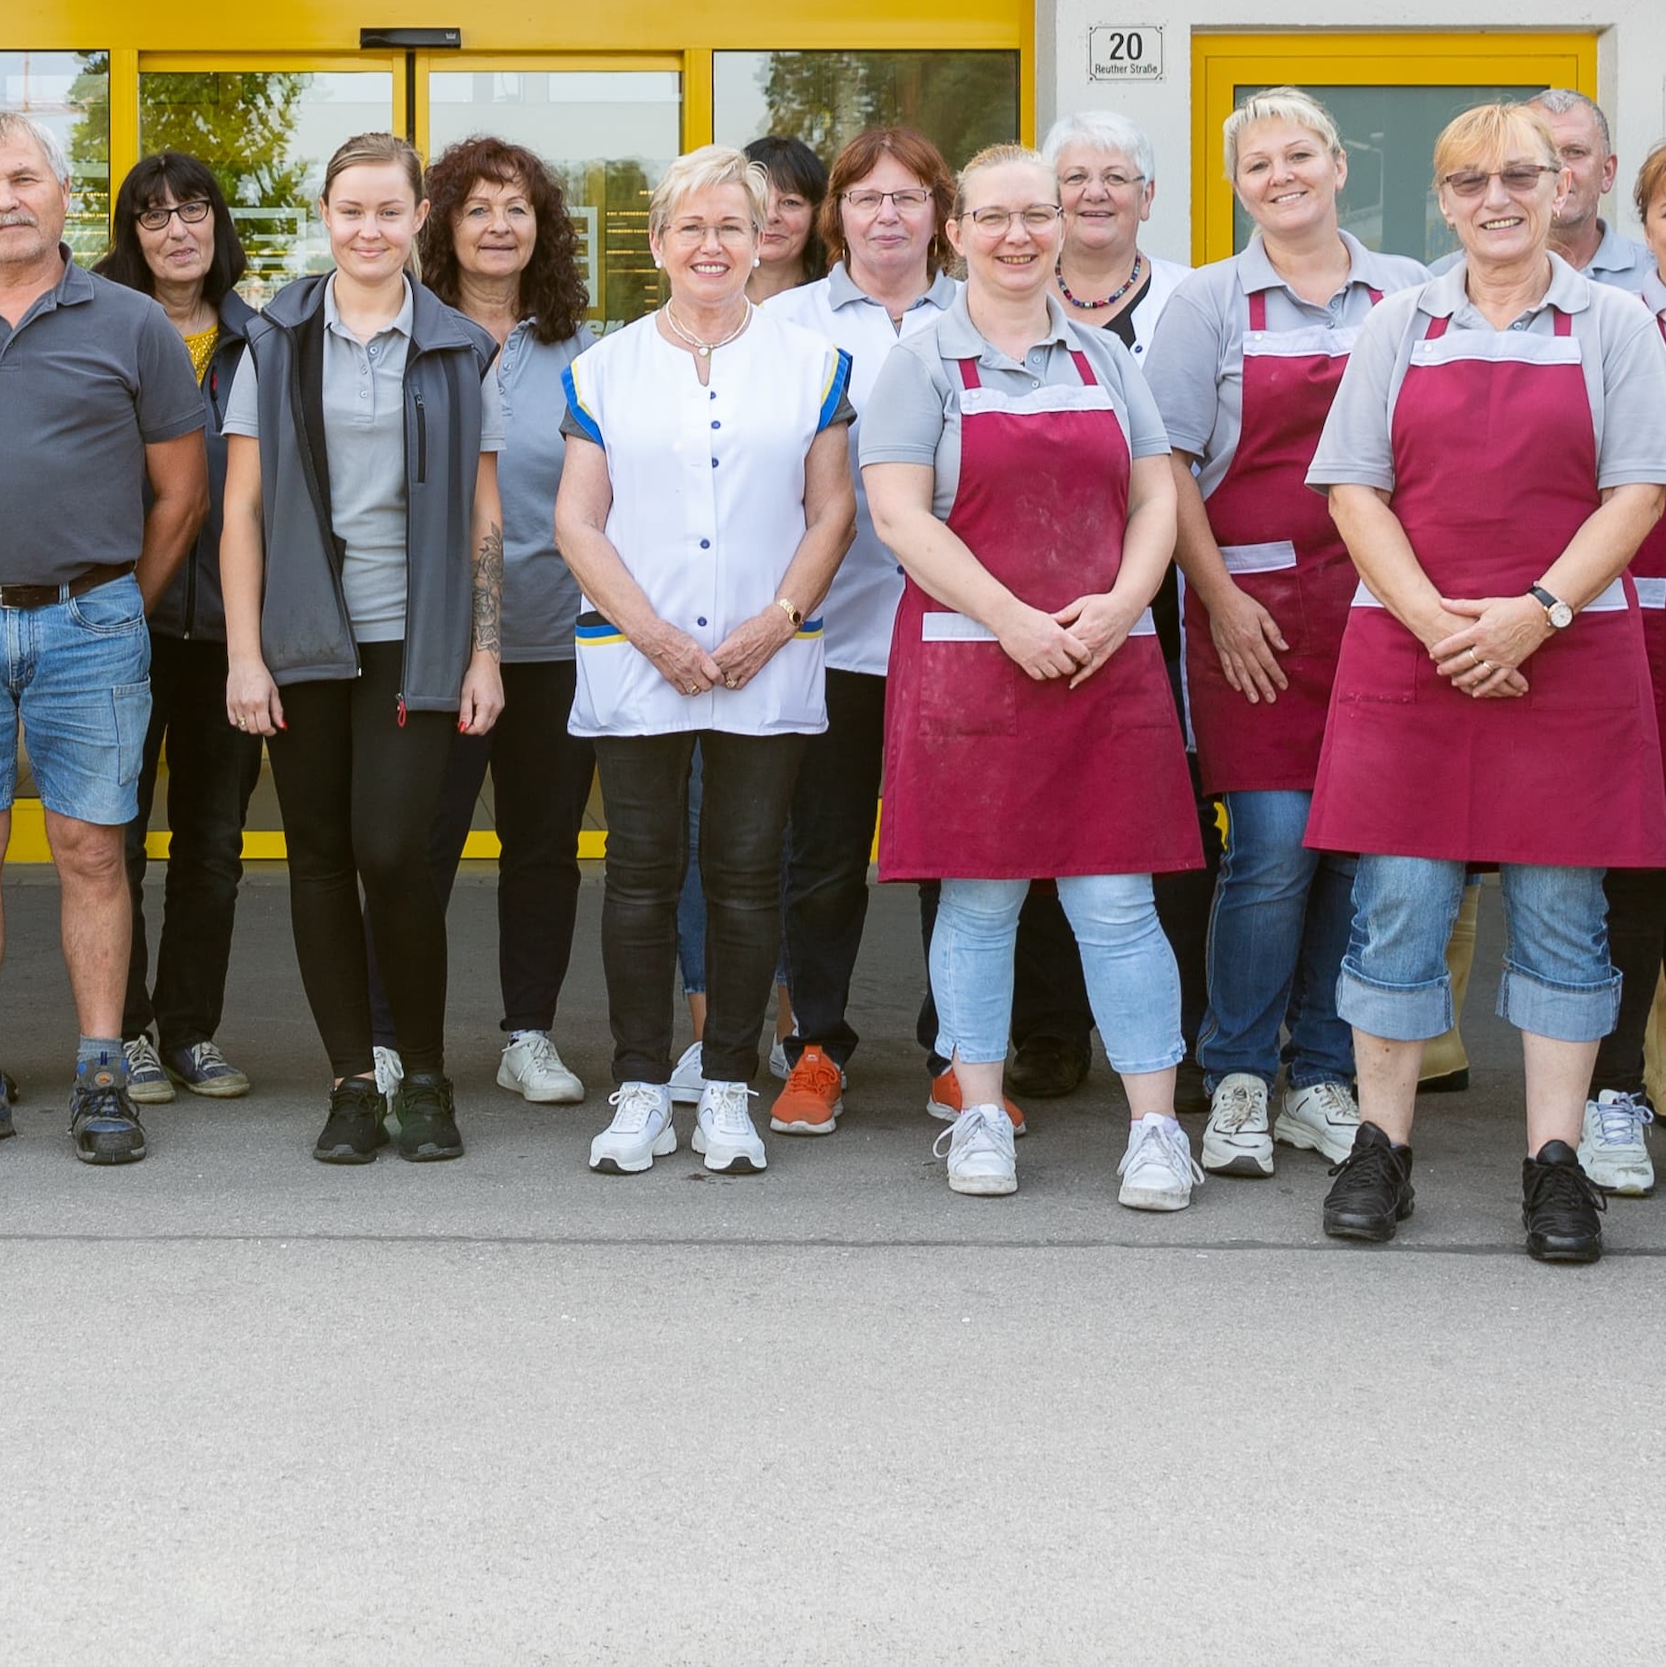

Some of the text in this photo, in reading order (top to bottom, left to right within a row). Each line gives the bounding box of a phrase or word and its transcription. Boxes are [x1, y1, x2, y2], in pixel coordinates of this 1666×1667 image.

[1109, 32, 1143, 61] 20
[1095, 63, 1158, 74] Reuther Straße
